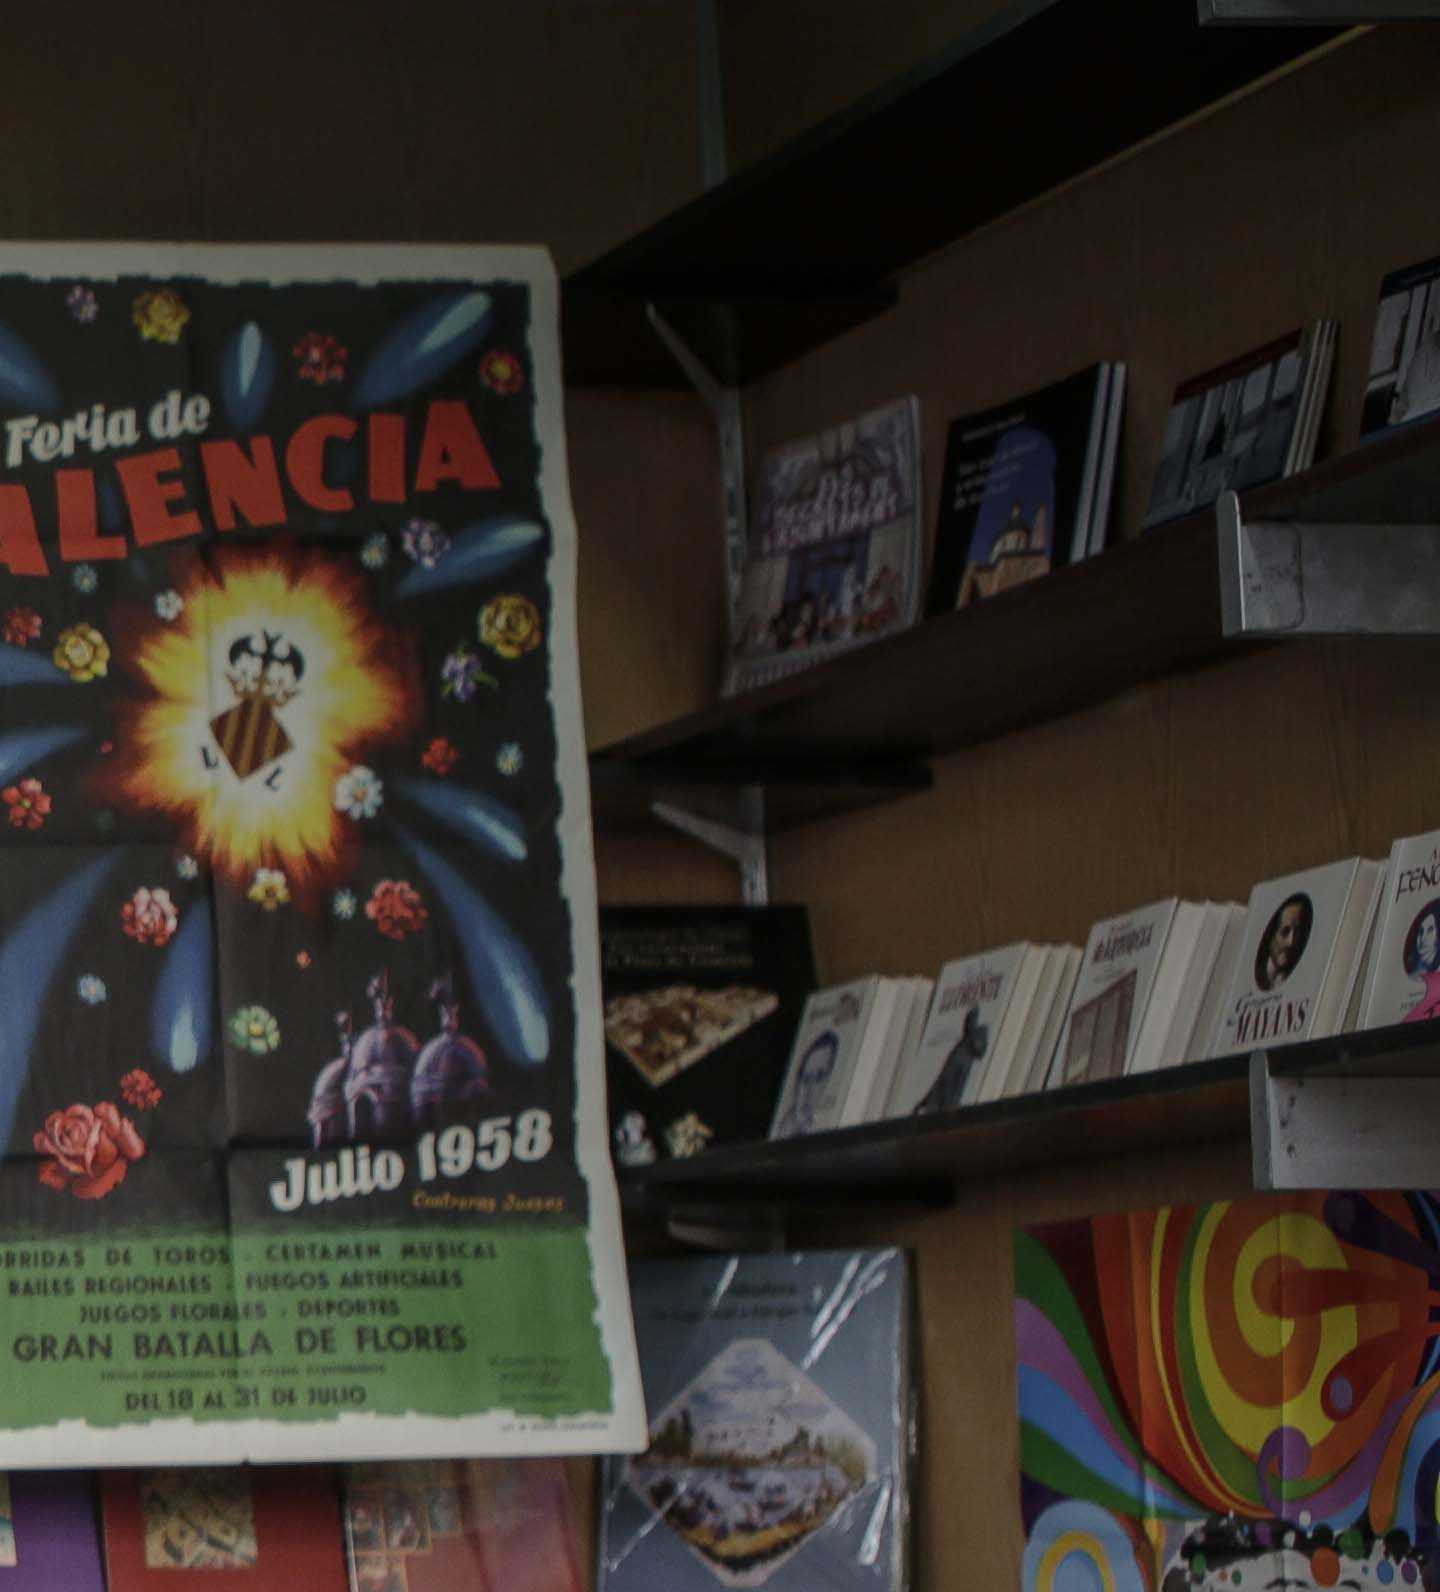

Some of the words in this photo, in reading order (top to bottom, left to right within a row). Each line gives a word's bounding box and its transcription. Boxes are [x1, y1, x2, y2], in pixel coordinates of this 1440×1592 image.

[5, 403, 139, 461] Feria
[149, 392, 212, 437] de
[268, 1144, 406, 1212] Julio
[417, 1108, 554, 1183] 1958
[105, 1248, 133, 1268] DE
[154, 1246, 233, 1267] TOROS
[265, 1243, 382, 1262] CERTAMEN
[400, 1241, 498, 1260] MUSICAL
[8, 1277, 75, 1297] BAILES
[84, 1274, 212, 1295] REGIONALES
[245, 1271, 330, 1291] FUEGOS
[339, 1268, 464, 1289] ARTIFICIALES
[80, 1303, 162, 1324] JUEGOS
[170, 1300, 268, 1322] FLORALES
[298, 1299, 401, 1319] DEPORTES
[12, 1332, 114, 1362] GRAN
[133, 1329, 273, 1359] BATALLA
[295, 1326, 337, 1355] DE
[355, 1323, 468, 1353] FLORES
[125, 1392, 161, 1411] DEL
[168, 1388, 194, 1410] 18
[203, 1391, 227, 1410] AL
[234, 1387, 261, 1408] 31
[271, 1388, 300, 1406] DE
[307, 1385, 367, 1404] JULIO
